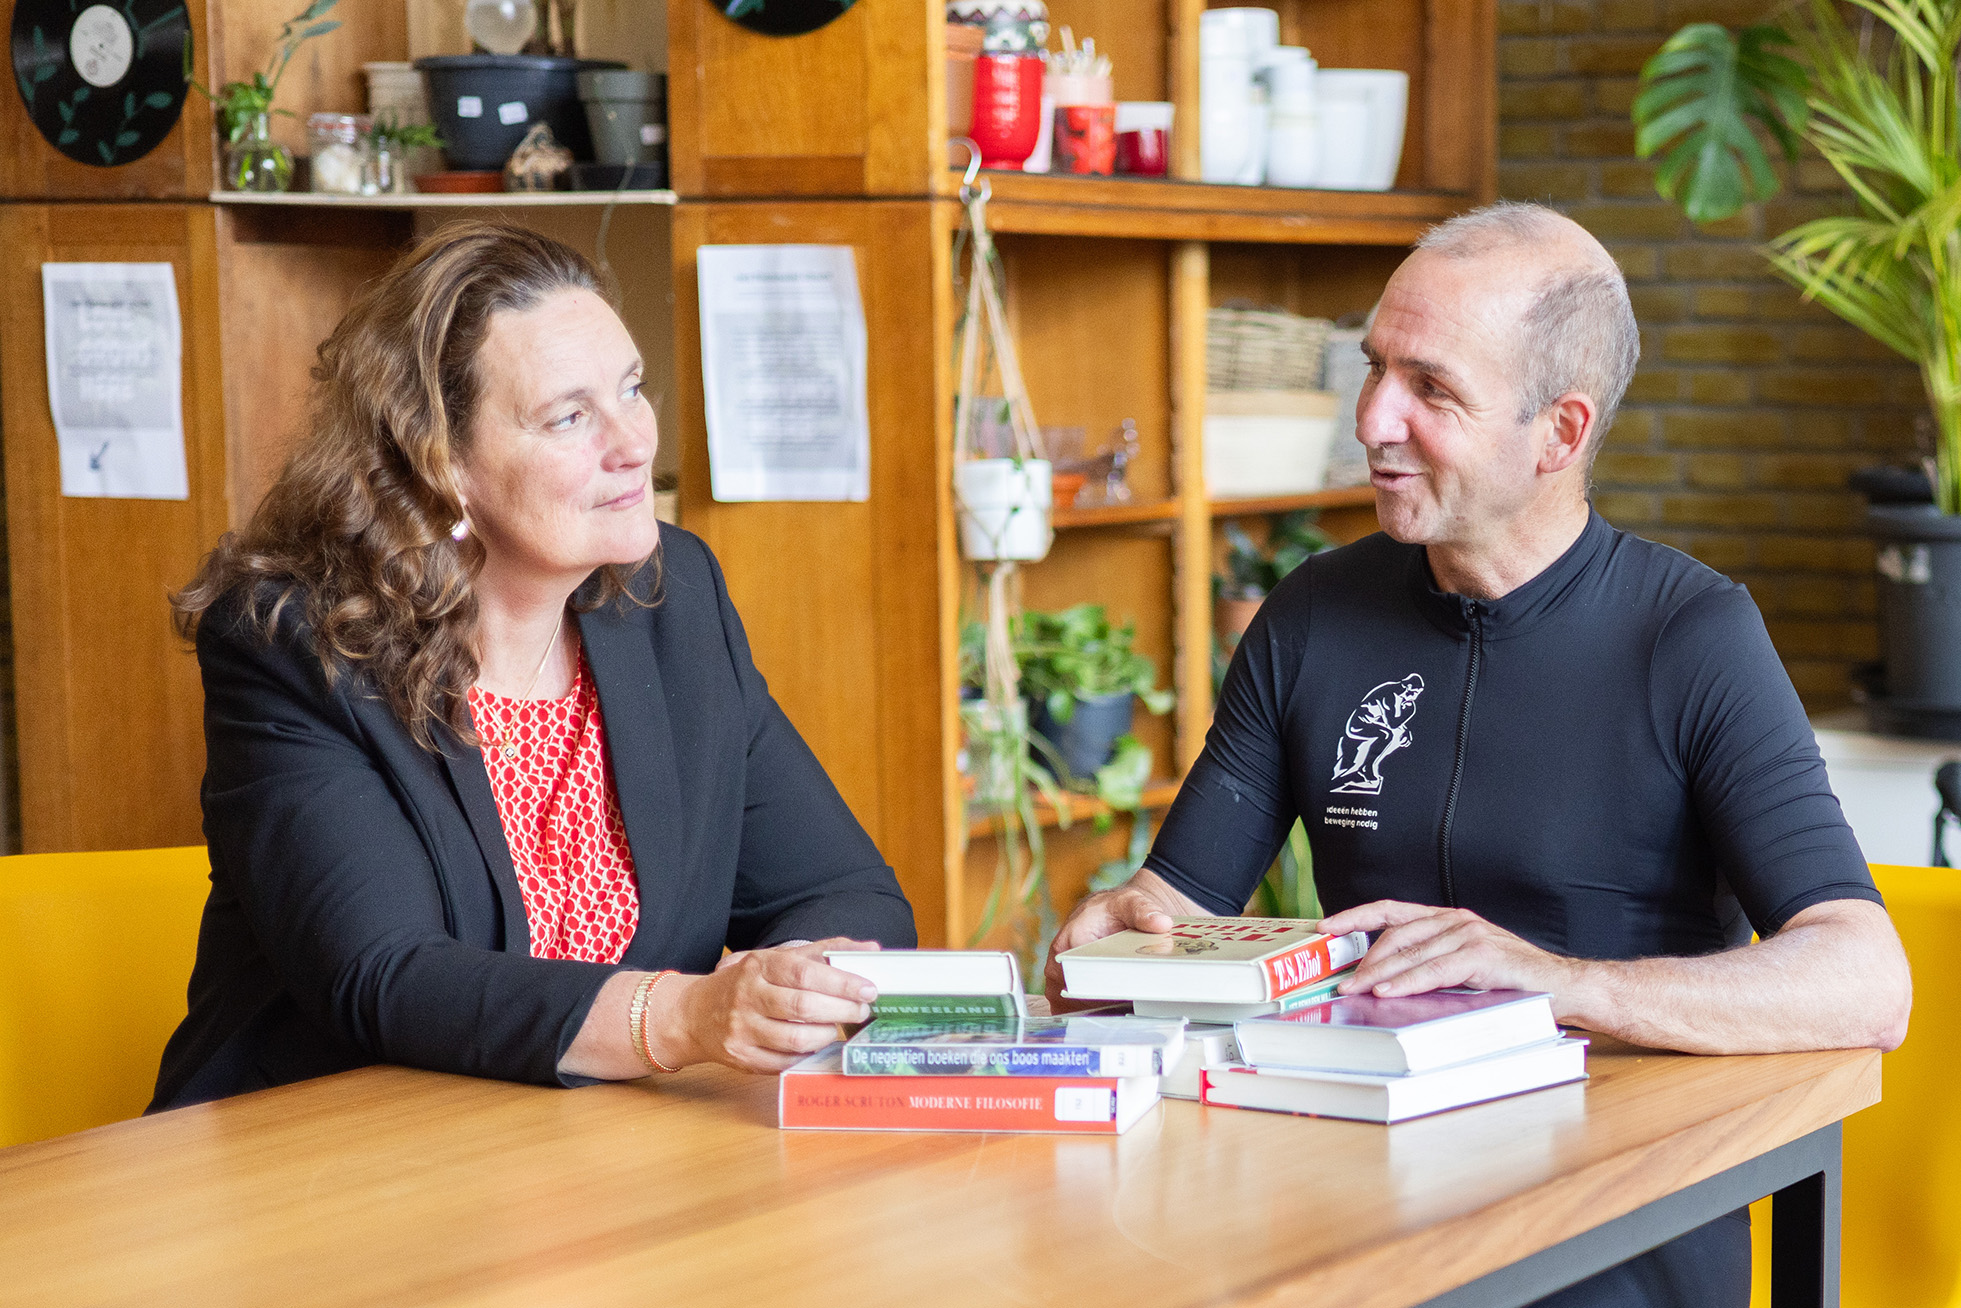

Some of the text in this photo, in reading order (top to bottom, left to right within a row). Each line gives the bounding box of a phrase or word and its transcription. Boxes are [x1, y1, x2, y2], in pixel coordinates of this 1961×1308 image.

[1350, 807, 1378, 817] hebben
[1324, 816, 1378, 830] beweging nodig
[1273, 953, 1299, 991] T.S.
[1294, 949, 1321, 983] Eliot
[872, 1006, 997, 1014] IMWEELAND
[852, 1048, 1090, 1068] De negentien boeken die ons boos maakten
[797, 1096, 840, 1107] ROGER
[909, 1096, 972, 1109] MODERNE
[976, 1097, 1043, 1110] FILOSOFIE
